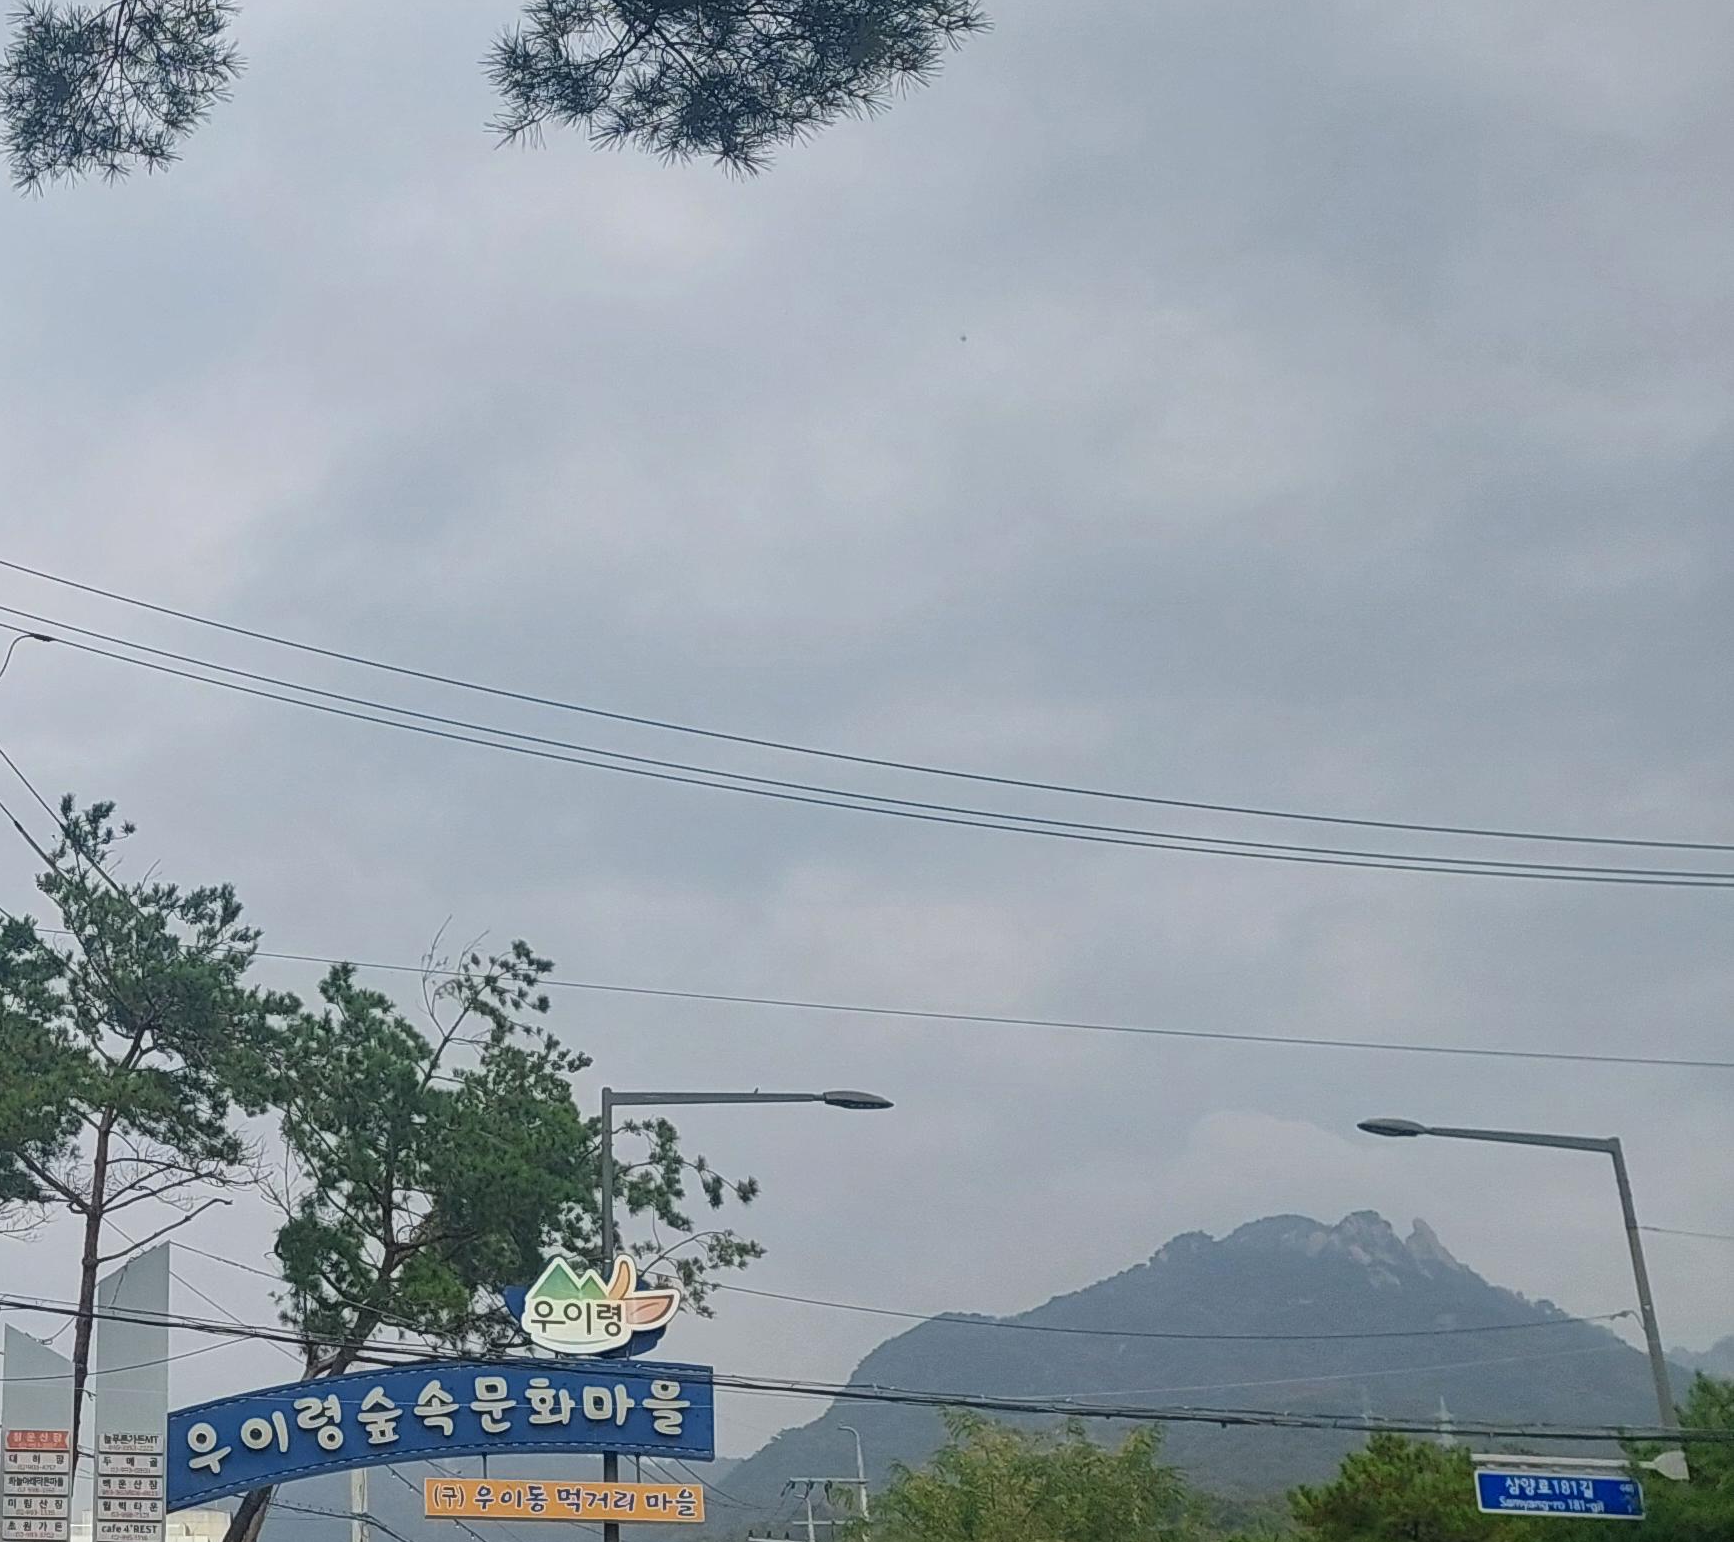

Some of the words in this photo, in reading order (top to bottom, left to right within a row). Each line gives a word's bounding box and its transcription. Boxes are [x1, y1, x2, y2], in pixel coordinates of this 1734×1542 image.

[531, 1300, 622, 1337] 우이령
[187, 1376, 690, 1475] 우이령숲속문화마을
[433, 1484, 465, 1509] (구)
[474, 1484, 548, 1513] 우이동
[557, 1487, 635, 1514] 먹거리
[645, 1488, 696, 1517] 마을
[1505, 1476, 1594, 1499] 삼양로181길
[1499, 1495, 1566, 1512] Samyang-ro
[1567, 1498, 1605, 1513] 181-gil
[101, 1523, 122, 1533] cafe
